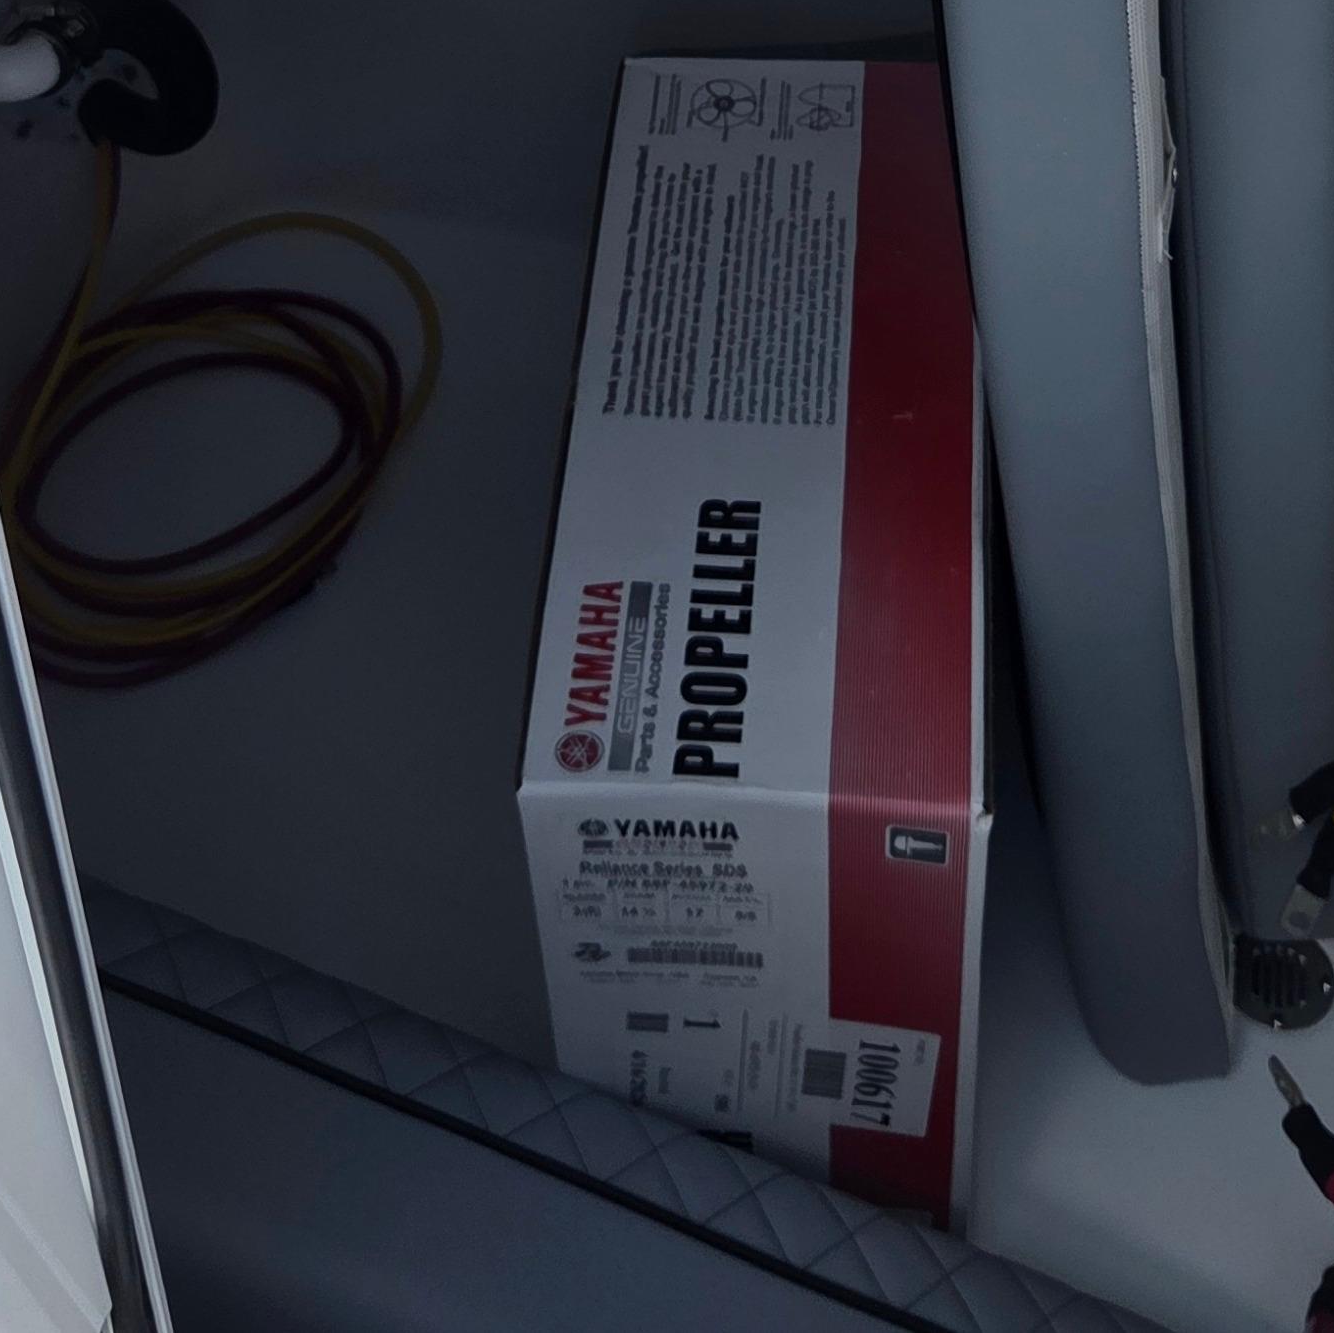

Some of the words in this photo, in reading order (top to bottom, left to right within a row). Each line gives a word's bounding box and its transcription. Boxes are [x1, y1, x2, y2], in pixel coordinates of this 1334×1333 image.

[566, 582, 622, 725] YAMAHA
[617, 620, 644, 732] GENUINE
[645, 583, 670, 697] Accessories
[674, 500, 759, 777] PROPELLER
[634, 722, 655, 773] Parts
[642, 704, 658, 717] &
[614, 819, 740, 841] YAMAHA
[850, 1039, 902, 1128] 100617
